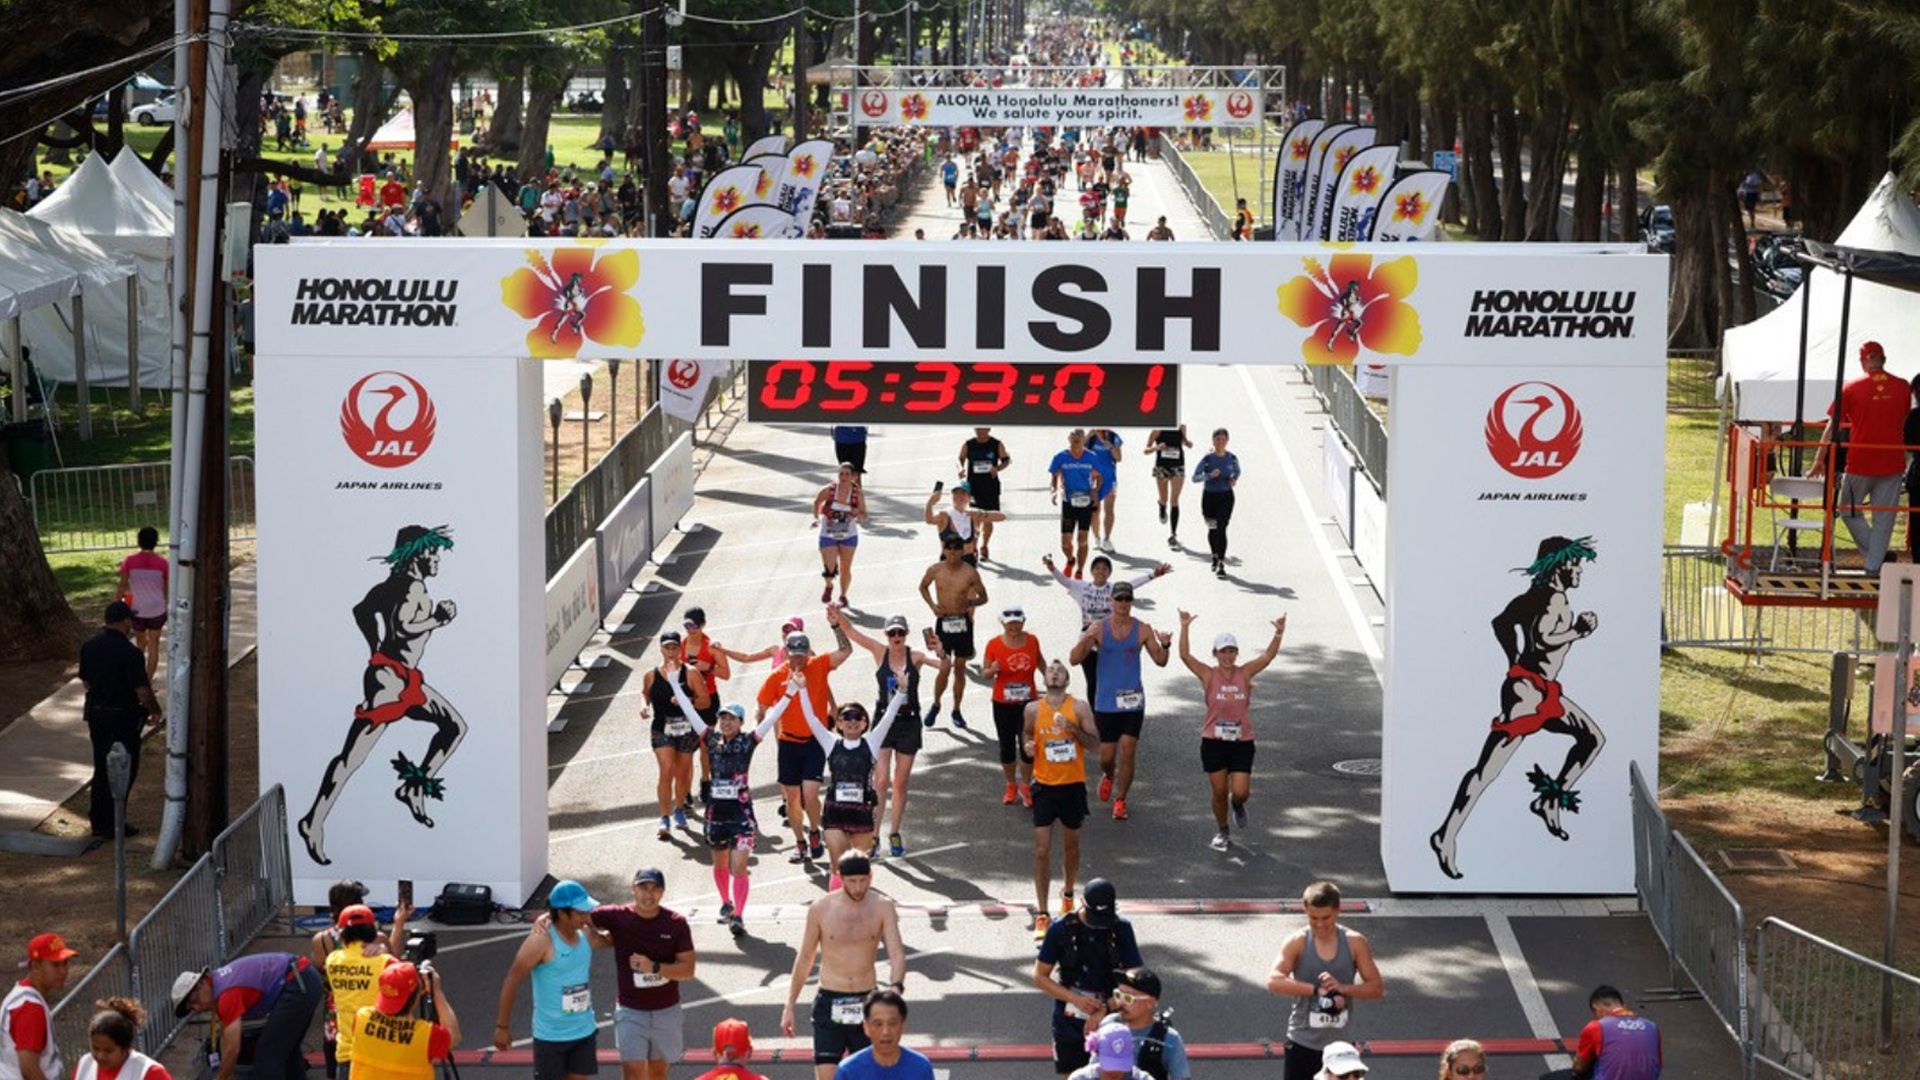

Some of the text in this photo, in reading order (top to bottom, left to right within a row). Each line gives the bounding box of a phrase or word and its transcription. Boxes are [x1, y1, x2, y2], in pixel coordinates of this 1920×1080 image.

[936, 94, 1180, 107] ALOHA Honolulu Marathoners!
[972, 107, 1143, 122] We salute your spirit.
[296, 278, 459, 303] HONOLULU
[701, 262, 1221, 352] FINISH
[1470, 290, 1637, 314] HONOLULU
[290, 302, 458, 327] MARATHON
[1464, 314, 1635, 339] MARATHON
[760, 360, 1164, 413] 05:33:01
[366, 440, 418, 456] JAL
[1510, 451, 1563, 467] JAL
[335, 481, 443, 490] JAPAN AIRLINES
[1477, 492, 1588, 501] JAPAN AIRLINES
[328, 964, 374, 977] OFFICIAL
[332, 978, 371, 991] CREW
[364, 1022, 415, 1046] CREW
